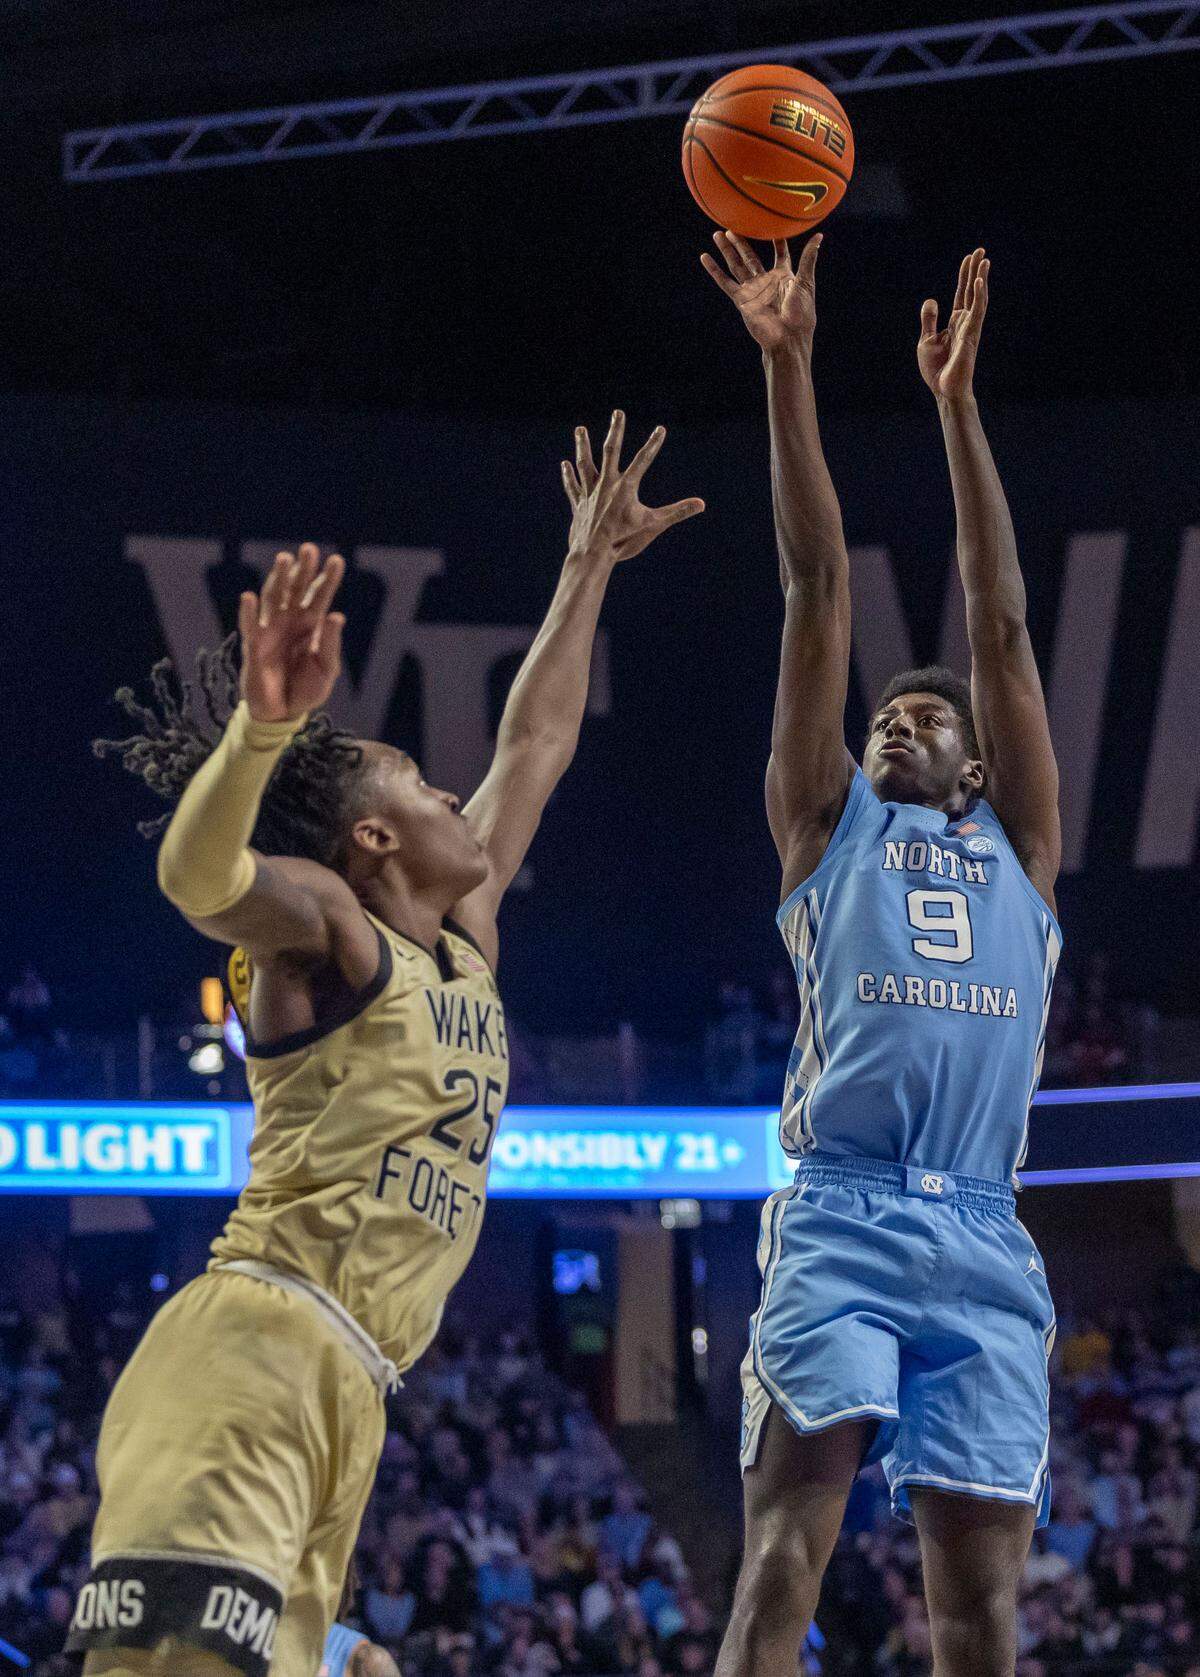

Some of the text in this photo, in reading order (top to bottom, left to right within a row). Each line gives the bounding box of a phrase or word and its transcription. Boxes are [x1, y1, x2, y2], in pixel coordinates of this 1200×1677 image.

[769, 105, 846, 159] ELITE
[882, 841, 988, 885] NORTH
[905, 889, 974, 964] 9
[857, 972, 1018, 1018] CAROLINA
[430, 1069, 501, 1165] 25
[26, 1123, 214, 1171] LIGHT
[494, 1131, 668, 1170] ONSIBLY
[71, 1579, 145, 1630] ONS
